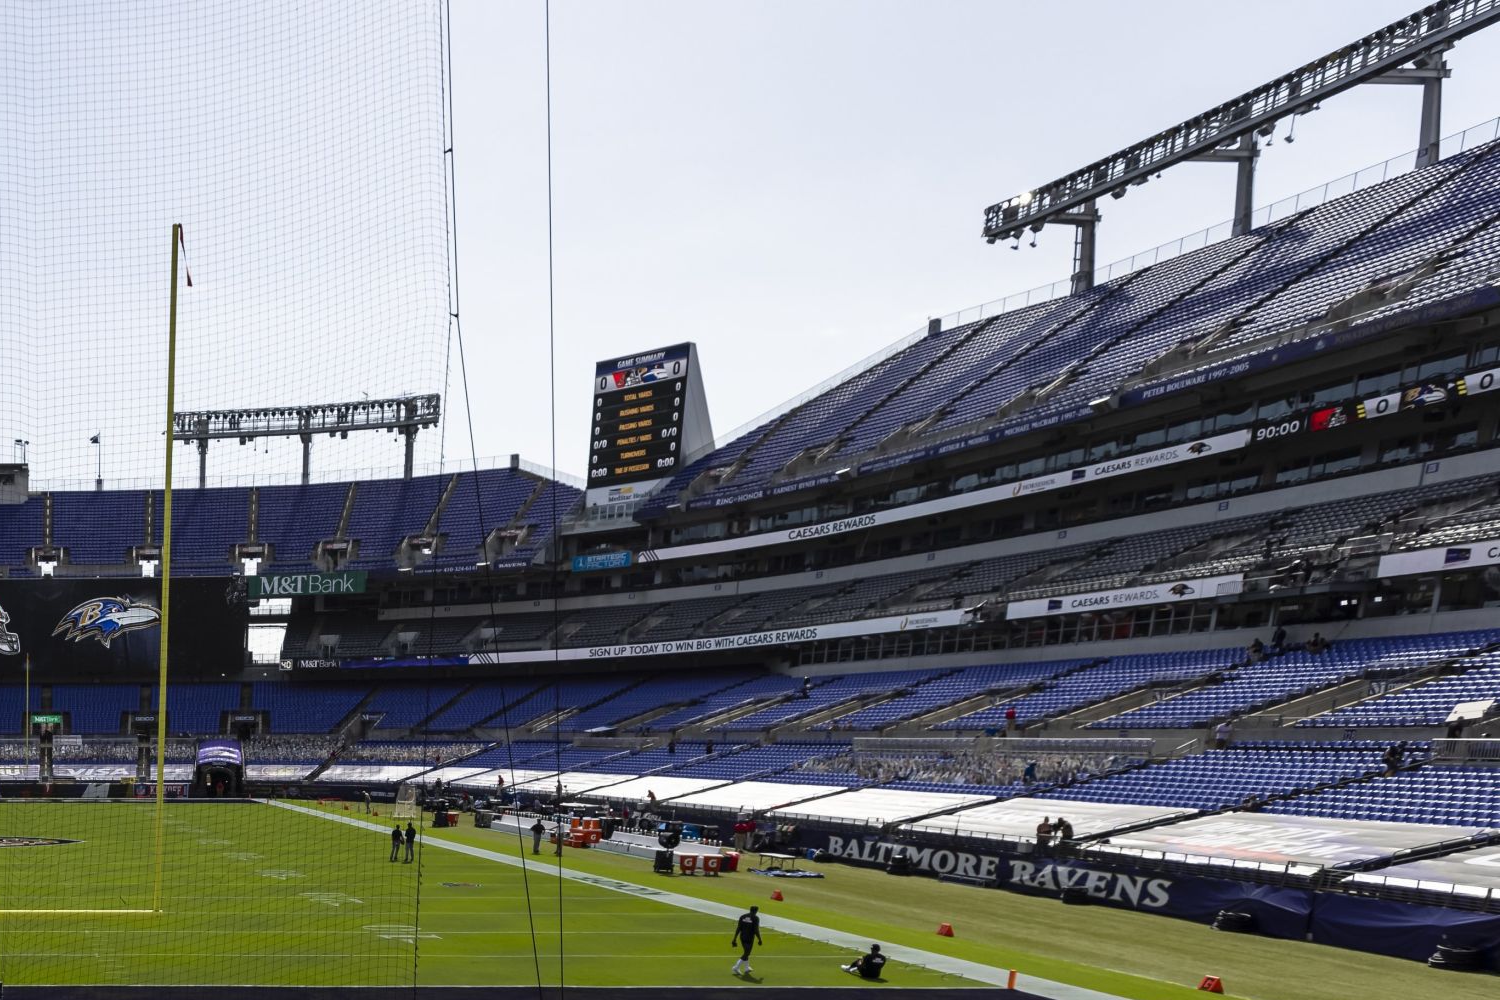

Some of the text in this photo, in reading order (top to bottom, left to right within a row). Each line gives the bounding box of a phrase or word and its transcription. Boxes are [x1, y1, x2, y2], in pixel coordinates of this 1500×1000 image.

[617, 352, 666, 369] GAME SUMMARY
[601, 361, 681, 390] 0 0
[1143, 361, 1250, 399] PETER BOULWARE 1997-2005
[1479, 371, 1494, 390] 0
[1376, 398, 1389, 415] 0
[1256, 419, 1300, 441] 90:00
[1094, 460, 1132, 476] CAESARS
[715, 496, 734, 506] RING
[738, 490, 764, 503] HONOR
[788, 514, 876, 540] CAESARS REWARDS
[498, 561, 527, 569] RAVENS
[260, 572, 354, 595] M&T Bank
[1071, 596, 1110, 609] CAESARS
[588, 628, 818, 658] SIGN UP TODAY TO WIN BIG WITH CAESARS REWARDS
[281, 659, 337, 670] 40 M&T Bank
[67, 767, 130, 777] VISA
[684, 857, 694, 868] G
[708, 858, 718, 869] G
[1008, 858, 1176, 908] RAVENS
